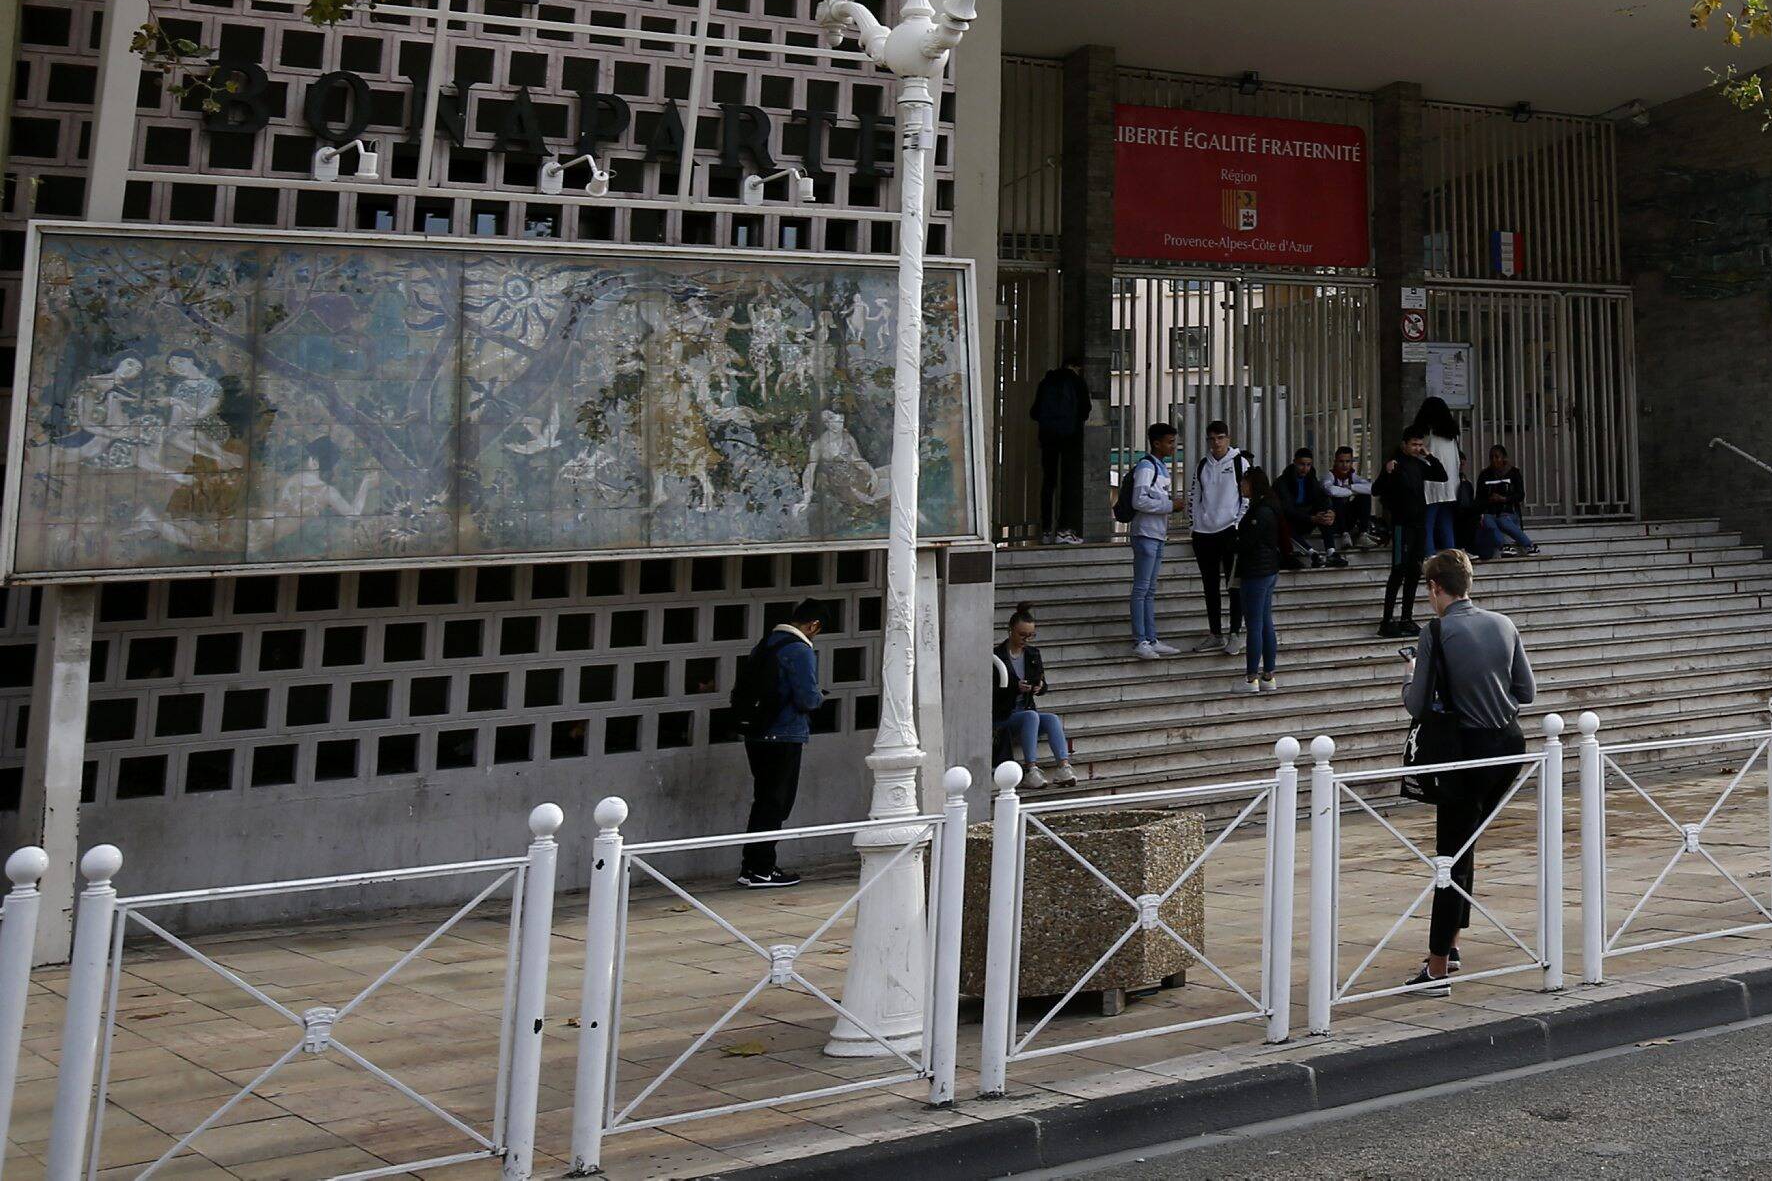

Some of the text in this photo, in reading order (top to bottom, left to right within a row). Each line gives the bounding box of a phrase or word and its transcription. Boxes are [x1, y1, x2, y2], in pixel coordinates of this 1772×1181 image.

[203, 60, 896, 176] BONAPARTE
[1113, 124, 1361, 162] IBERTÉ ÉGALITÉ FRATERNITÉ
[1221, 168, 1258, 184] Région
[1163, 233, 1314, 254] Provence-Alpes-Côte d'Azur
